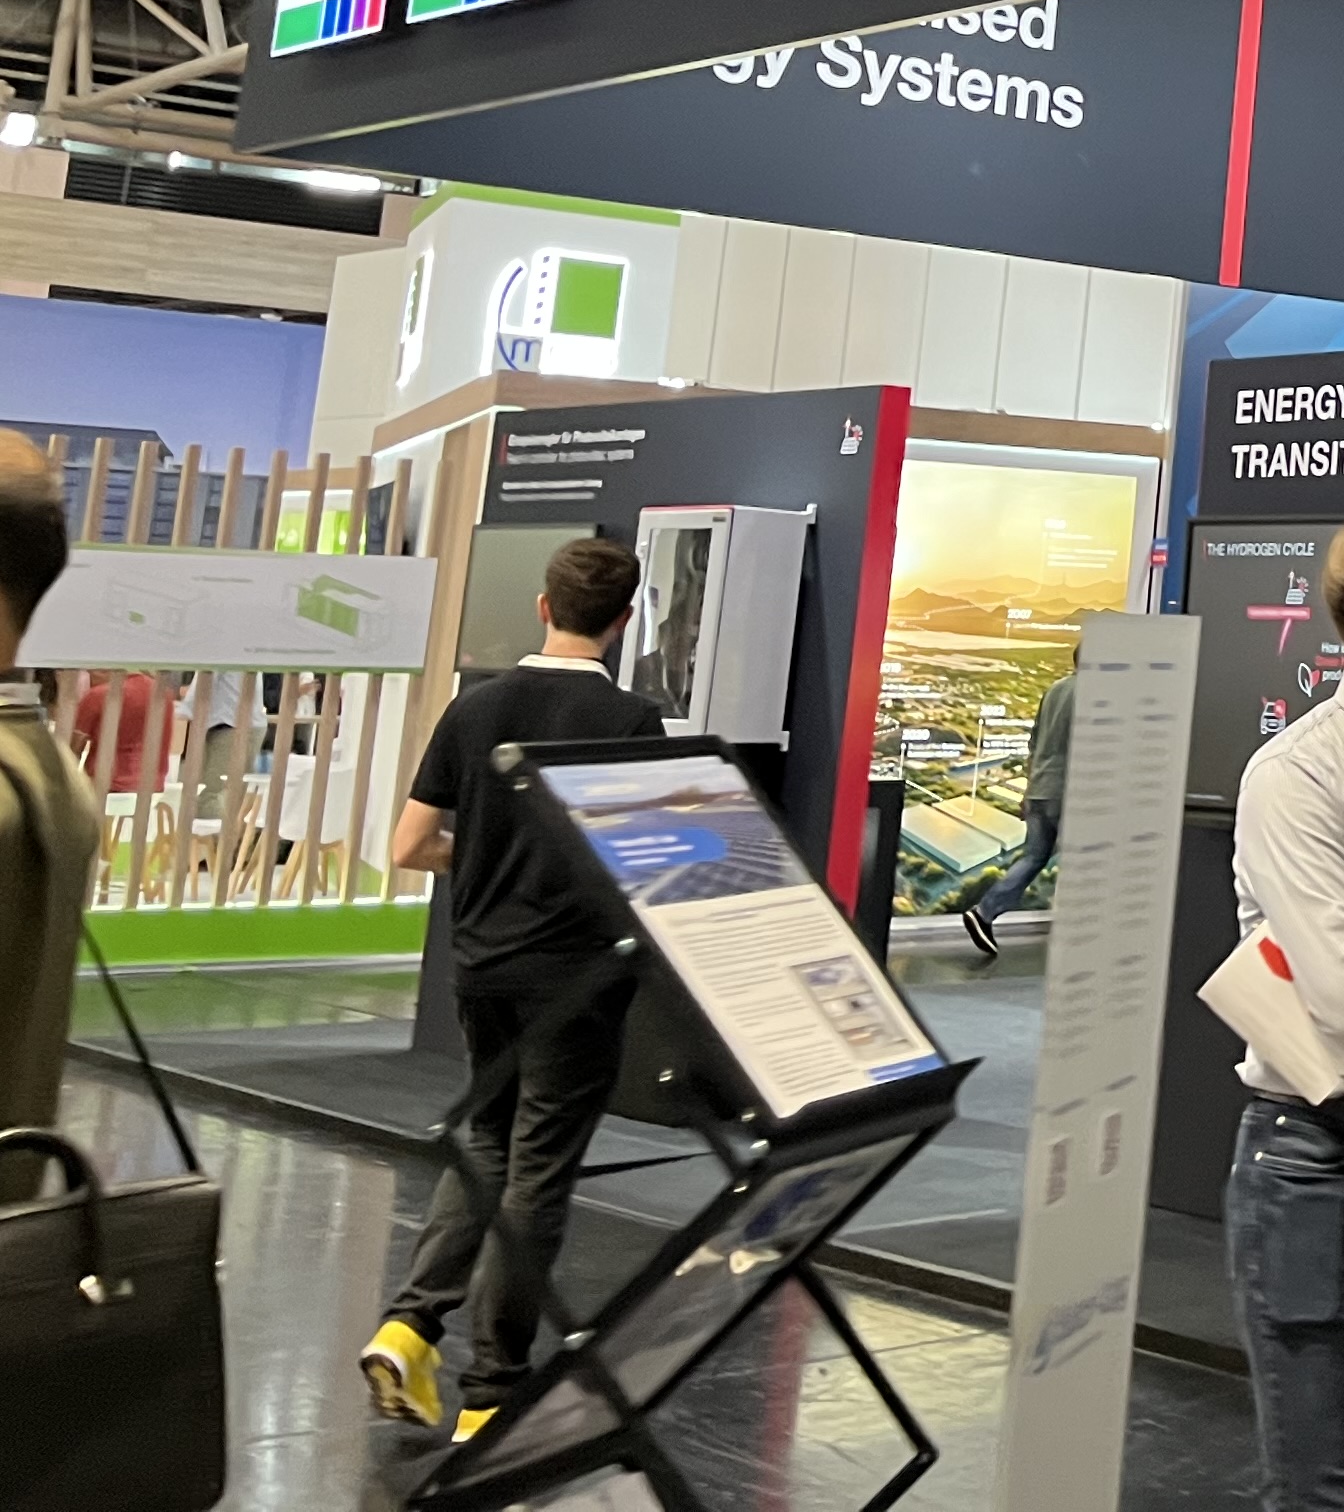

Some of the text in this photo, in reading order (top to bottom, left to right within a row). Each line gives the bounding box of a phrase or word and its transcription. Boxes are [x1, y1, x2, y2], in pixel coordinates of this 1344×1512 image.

[815, 35, 1084, 129] Systems
[1207, 542, 1315, 557] THE HYDROGEN CYCLE
